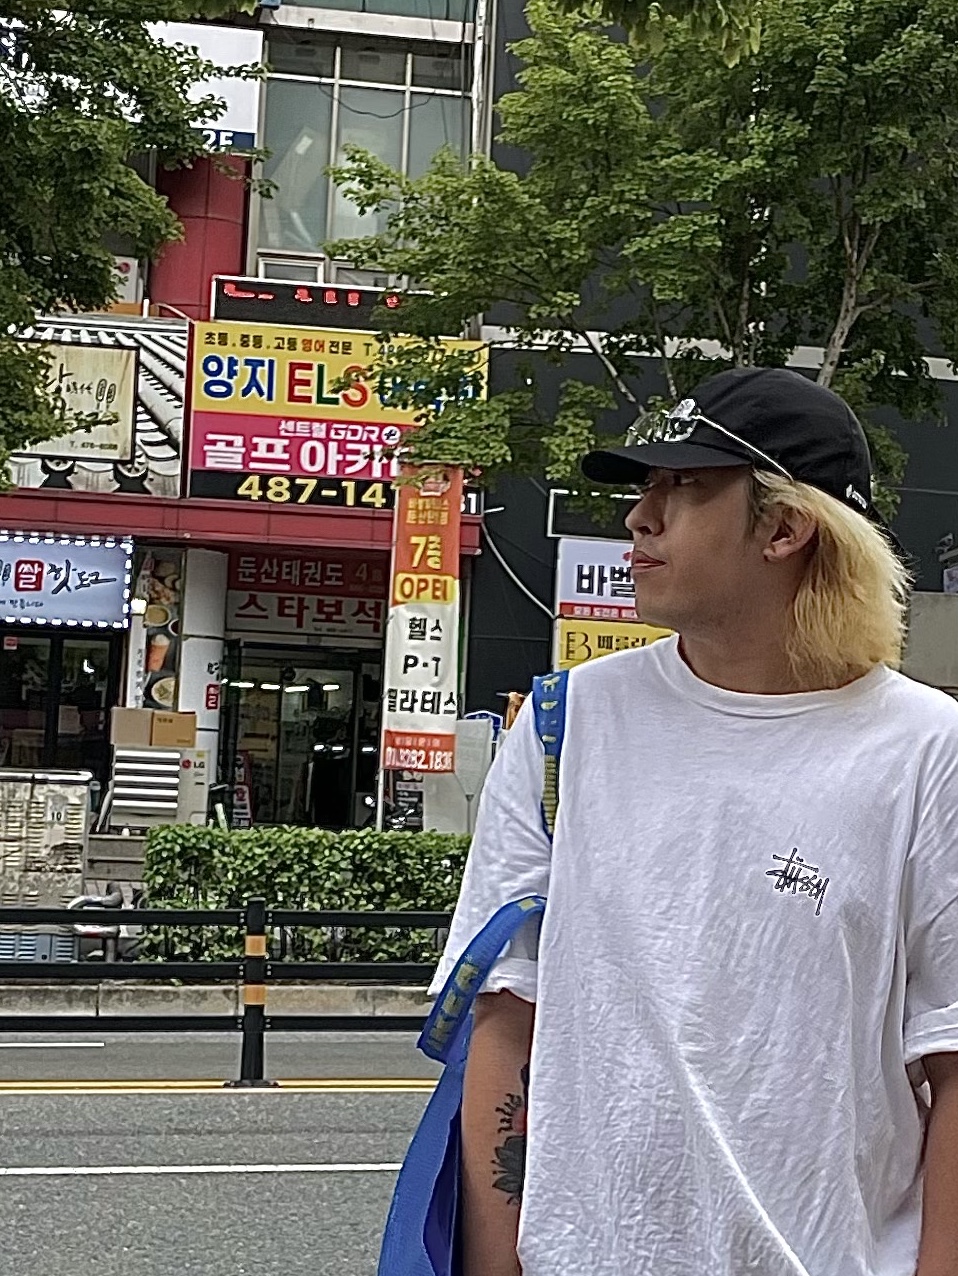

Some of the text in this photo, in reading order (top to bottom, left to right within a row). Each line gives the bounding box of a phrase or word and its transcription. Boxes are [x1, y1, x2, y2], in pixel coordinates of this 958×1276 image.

[202, 354, 275, 401] 양지
[287, 362, 369, 407] ELS
[237, 475, 399, 508] 487-14
[237, 556, 344, 586] 둔산태권도
[235, 593, 383, 633] 스타보석
[408, 617, 443, 641] 헬스
